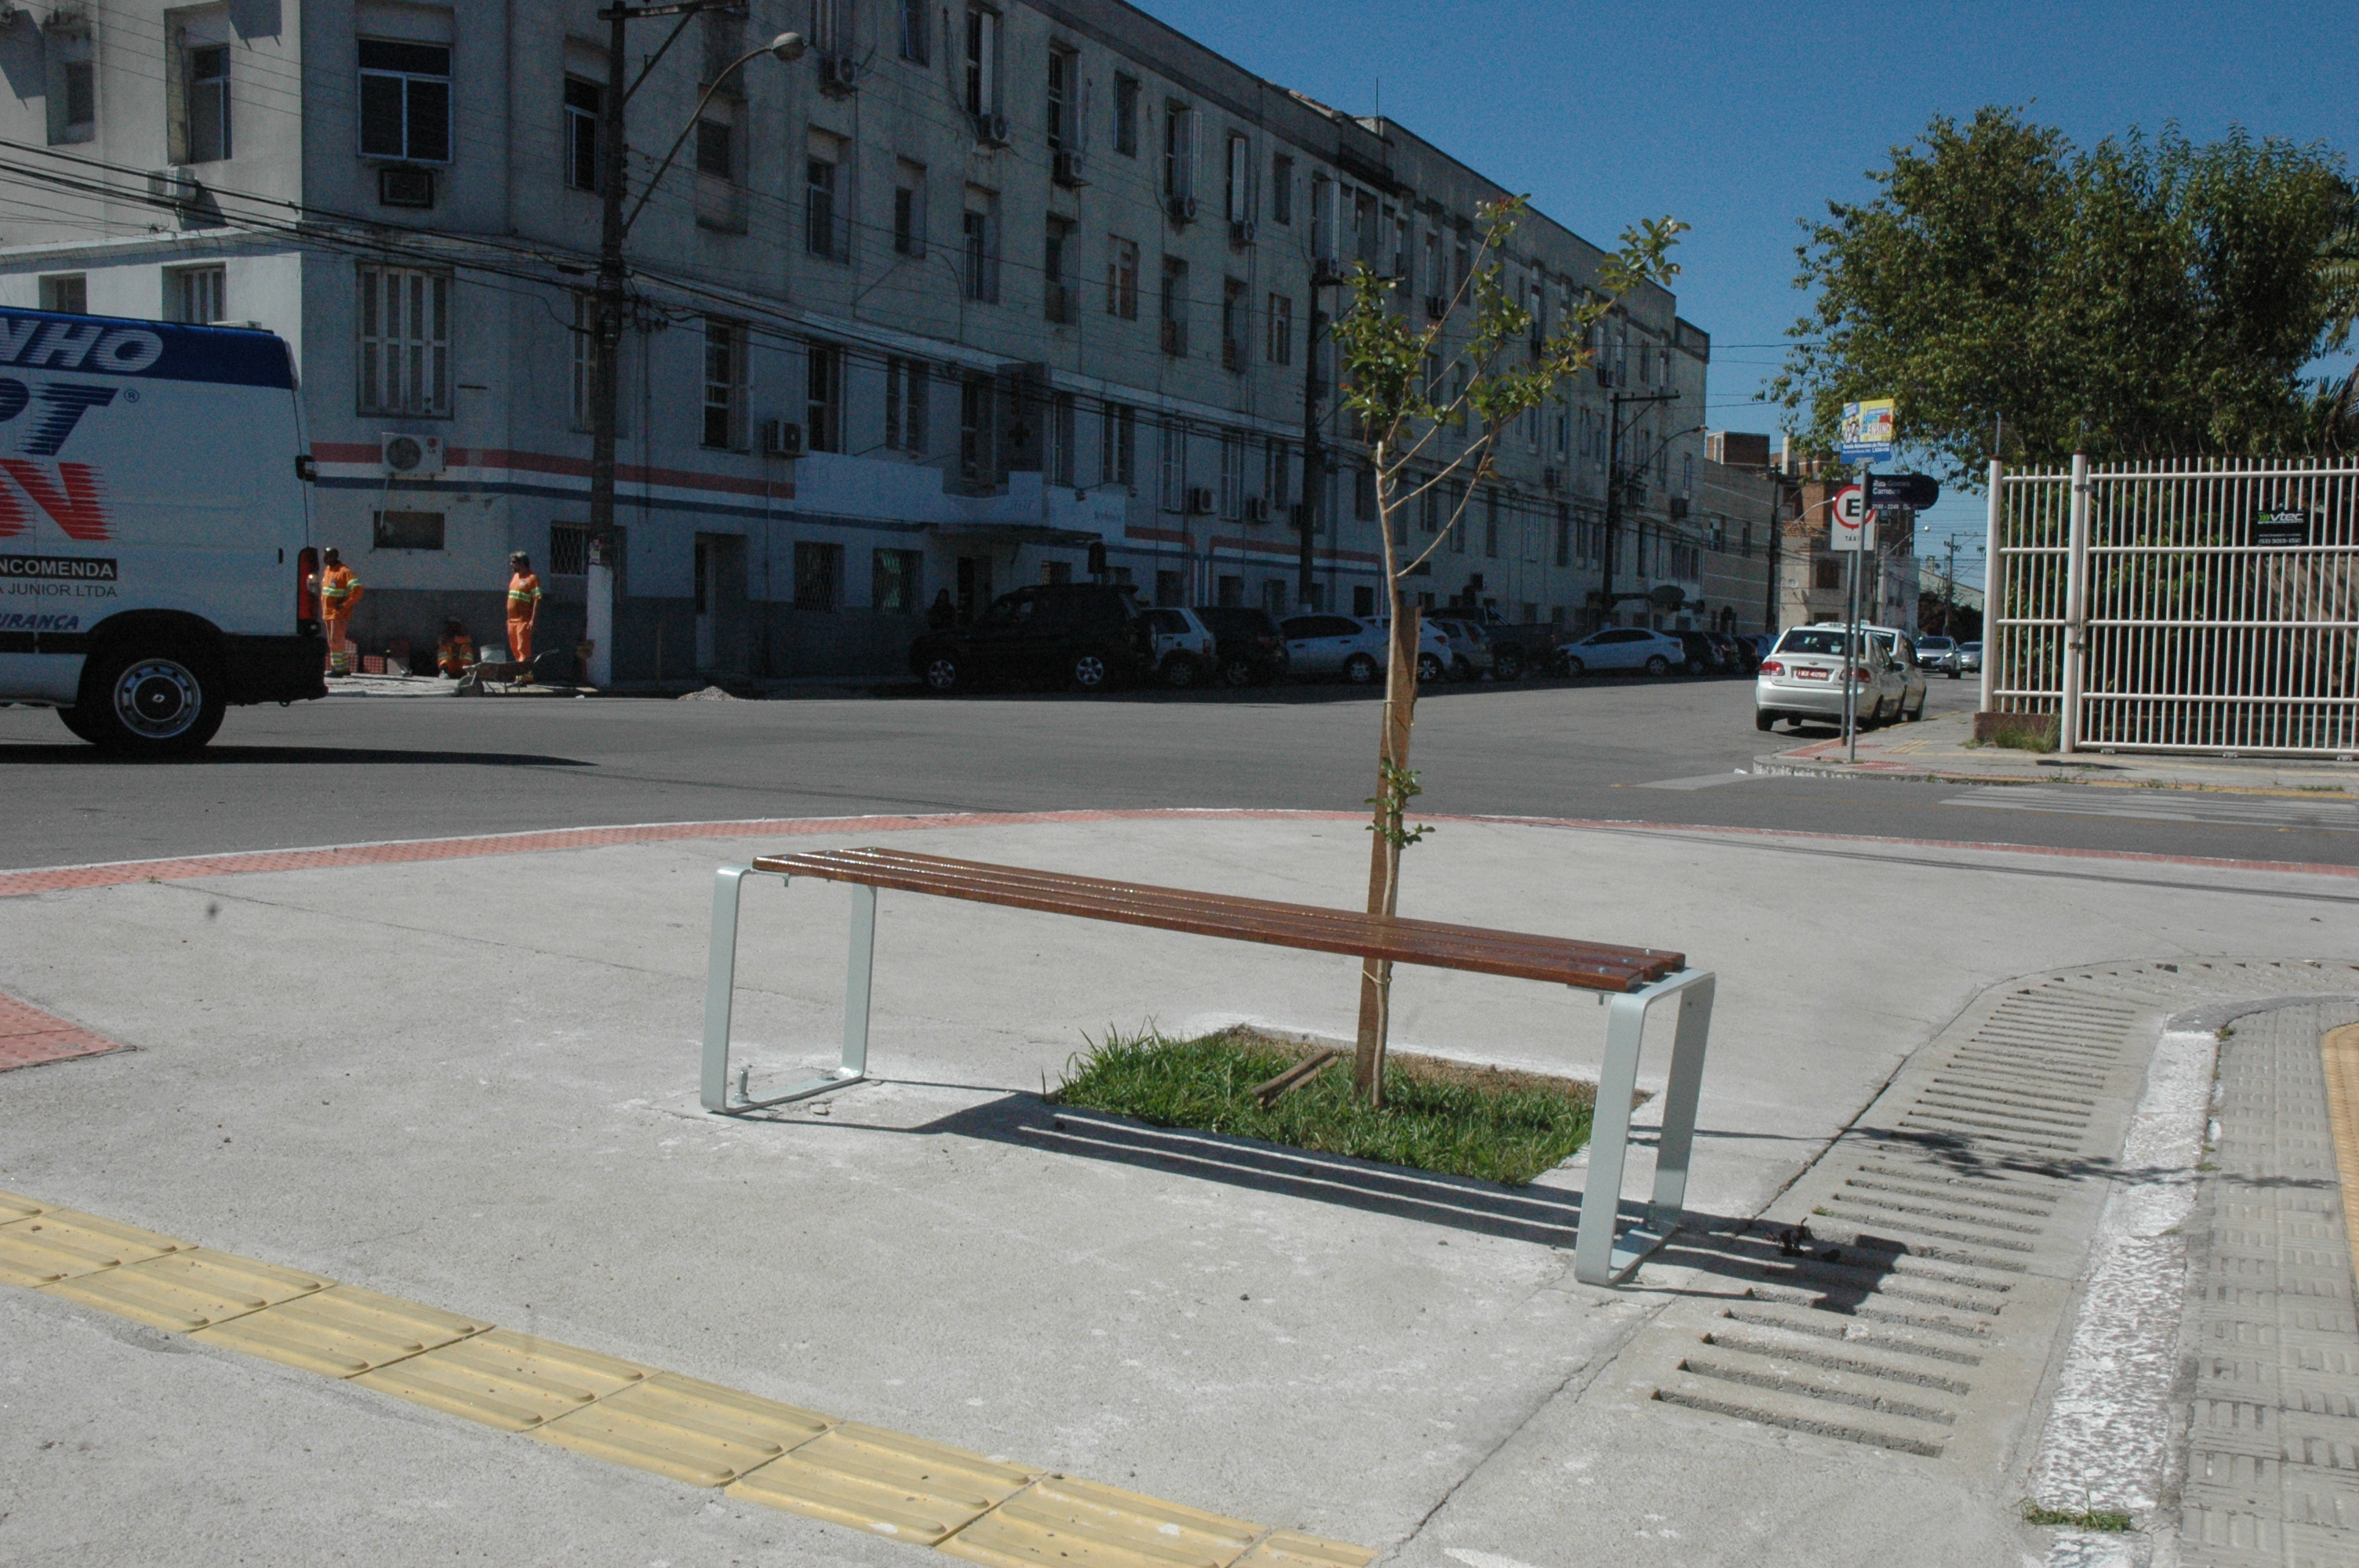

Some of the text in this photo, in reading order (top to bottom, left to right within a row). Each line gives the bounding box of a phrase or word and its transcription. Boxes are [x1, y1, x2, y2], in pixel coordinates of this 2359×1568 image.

[0, 316, 164, 372] NHO
[1845, 499, 1861, 517] E
[8, 583, 71, 597] JUNIOR
[76, 584, 118, 597] LTDA
